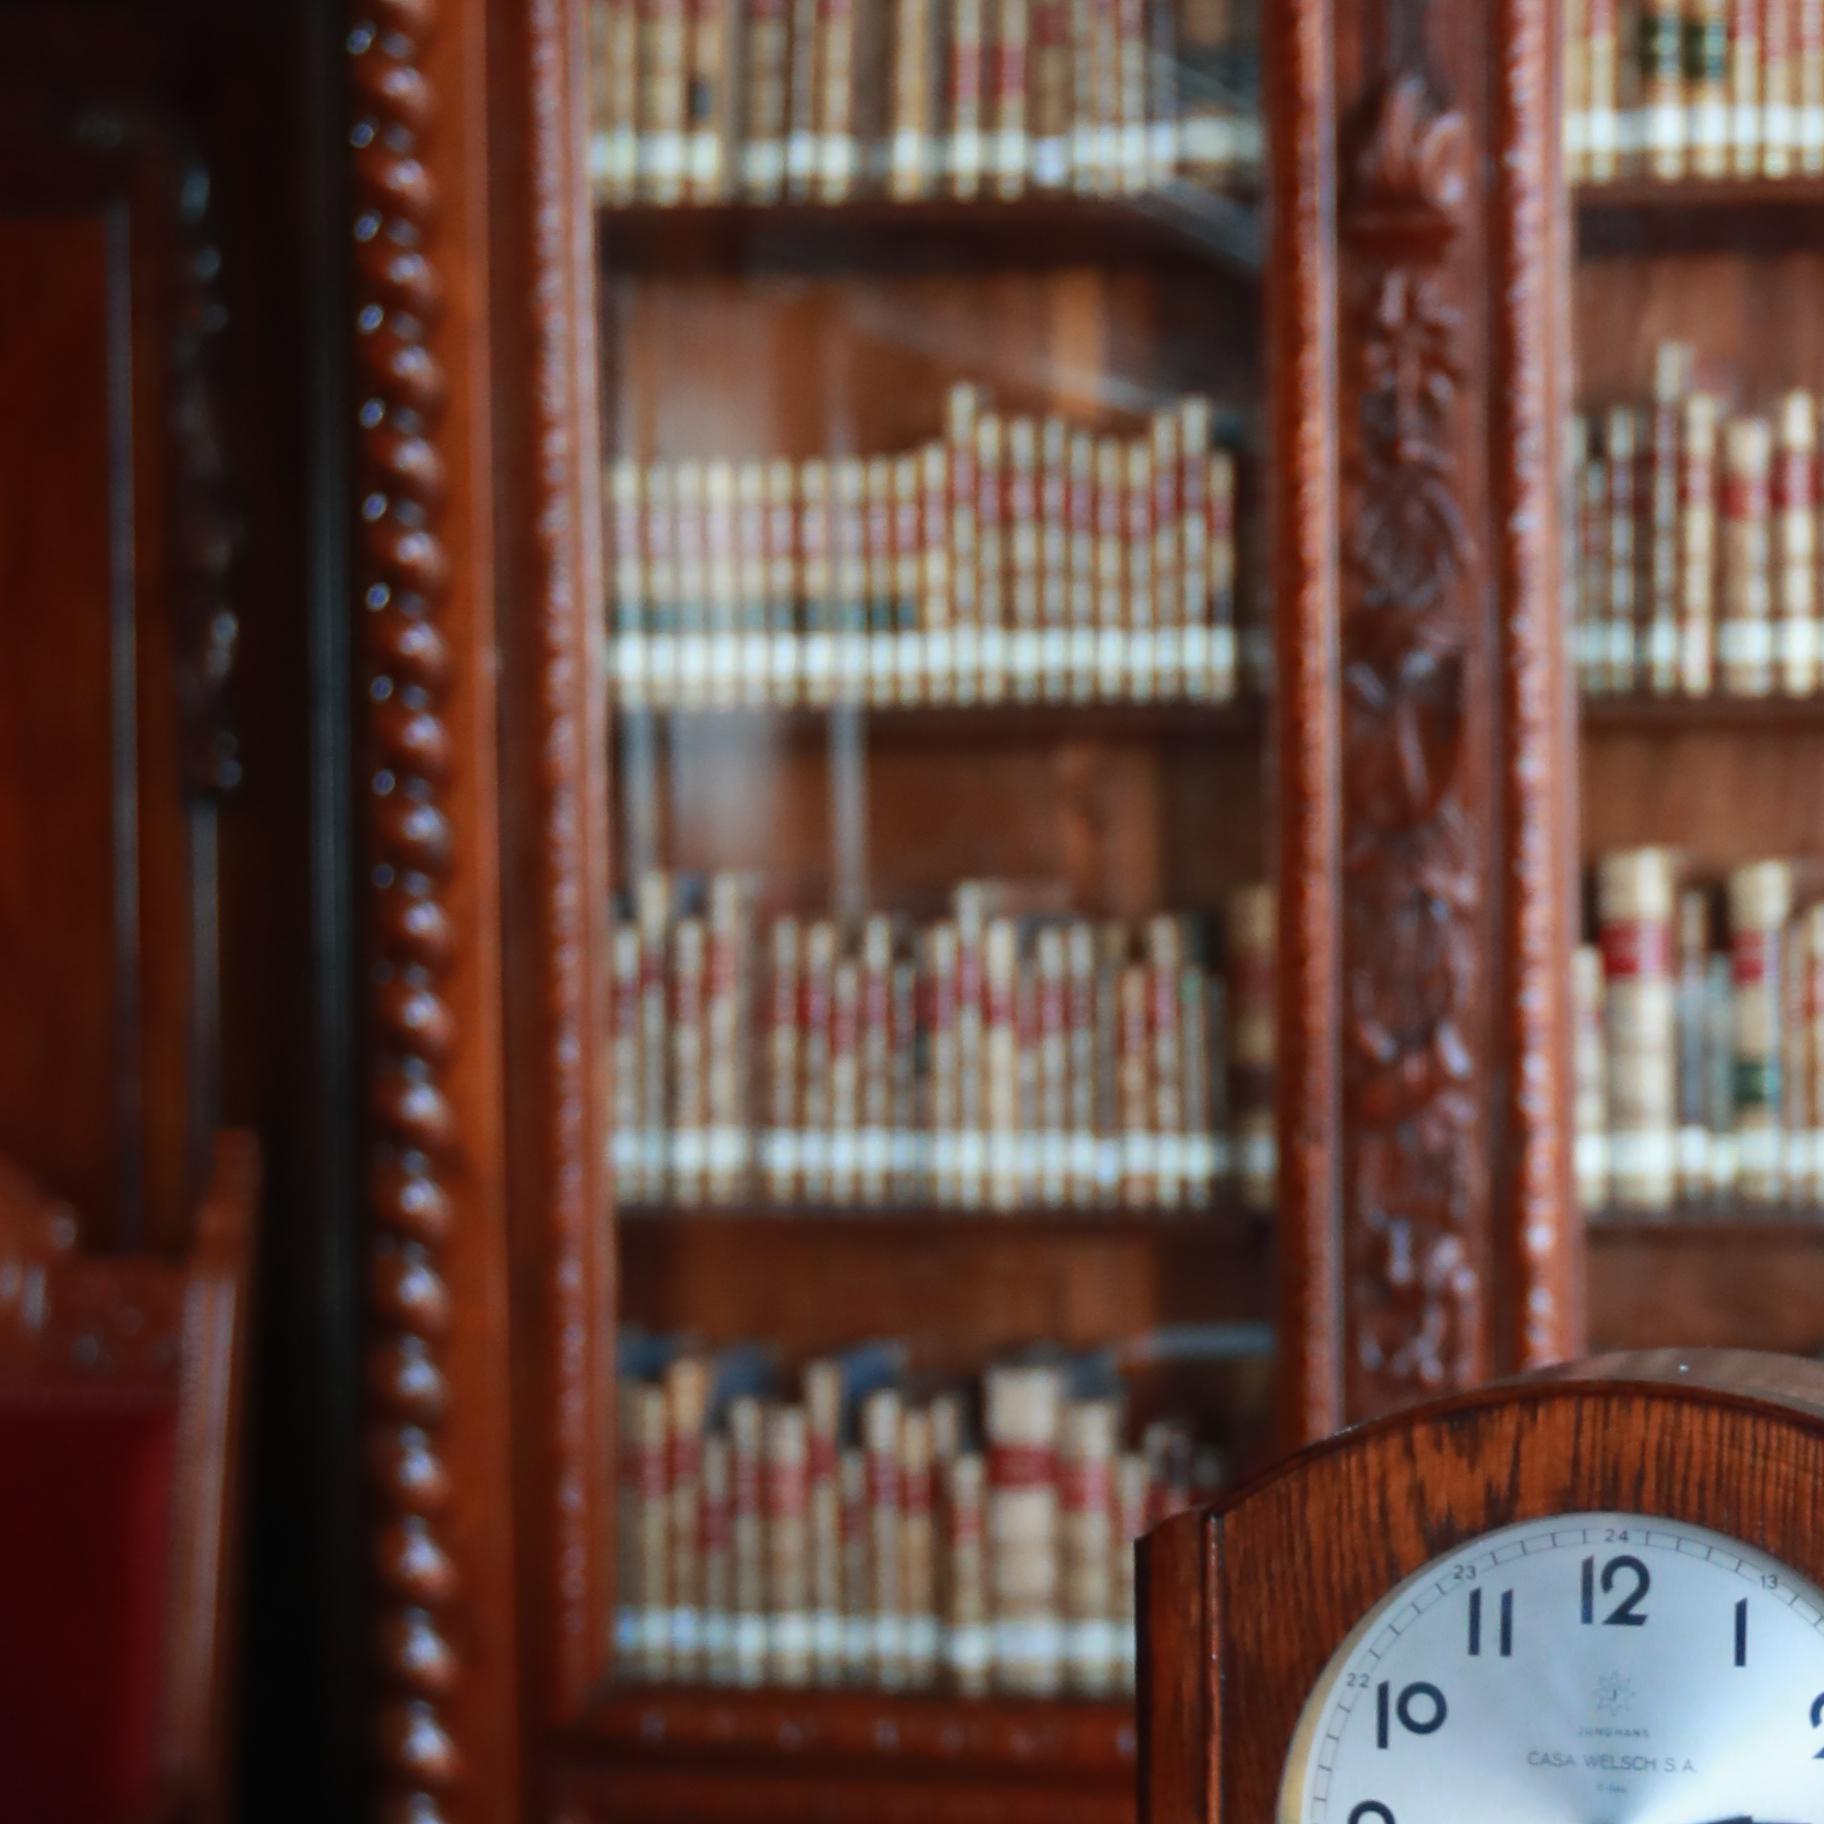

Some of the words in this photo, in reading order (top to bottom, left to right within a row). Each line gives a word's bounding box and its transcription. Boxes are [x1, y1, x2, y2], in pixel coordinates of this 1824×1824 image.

[1604, 1529, 1629, 1543] 24
[1453, 1565, 1476, 1579] 23
[1761, 1576, 1778, 1589] 13
[1582, 1554, 1650, 1626] 12
[1468, 1587, 1513, 1657] 11
[1734, 1597, 1748, 1667] 1
[1347, 1673, 1369, 1688] 22
[1377, 1680, 1447, 1749] 10
[1527, 1750, 1576, 1768] CASA
[1583, 1753, 1657, 1772] WELSCH
